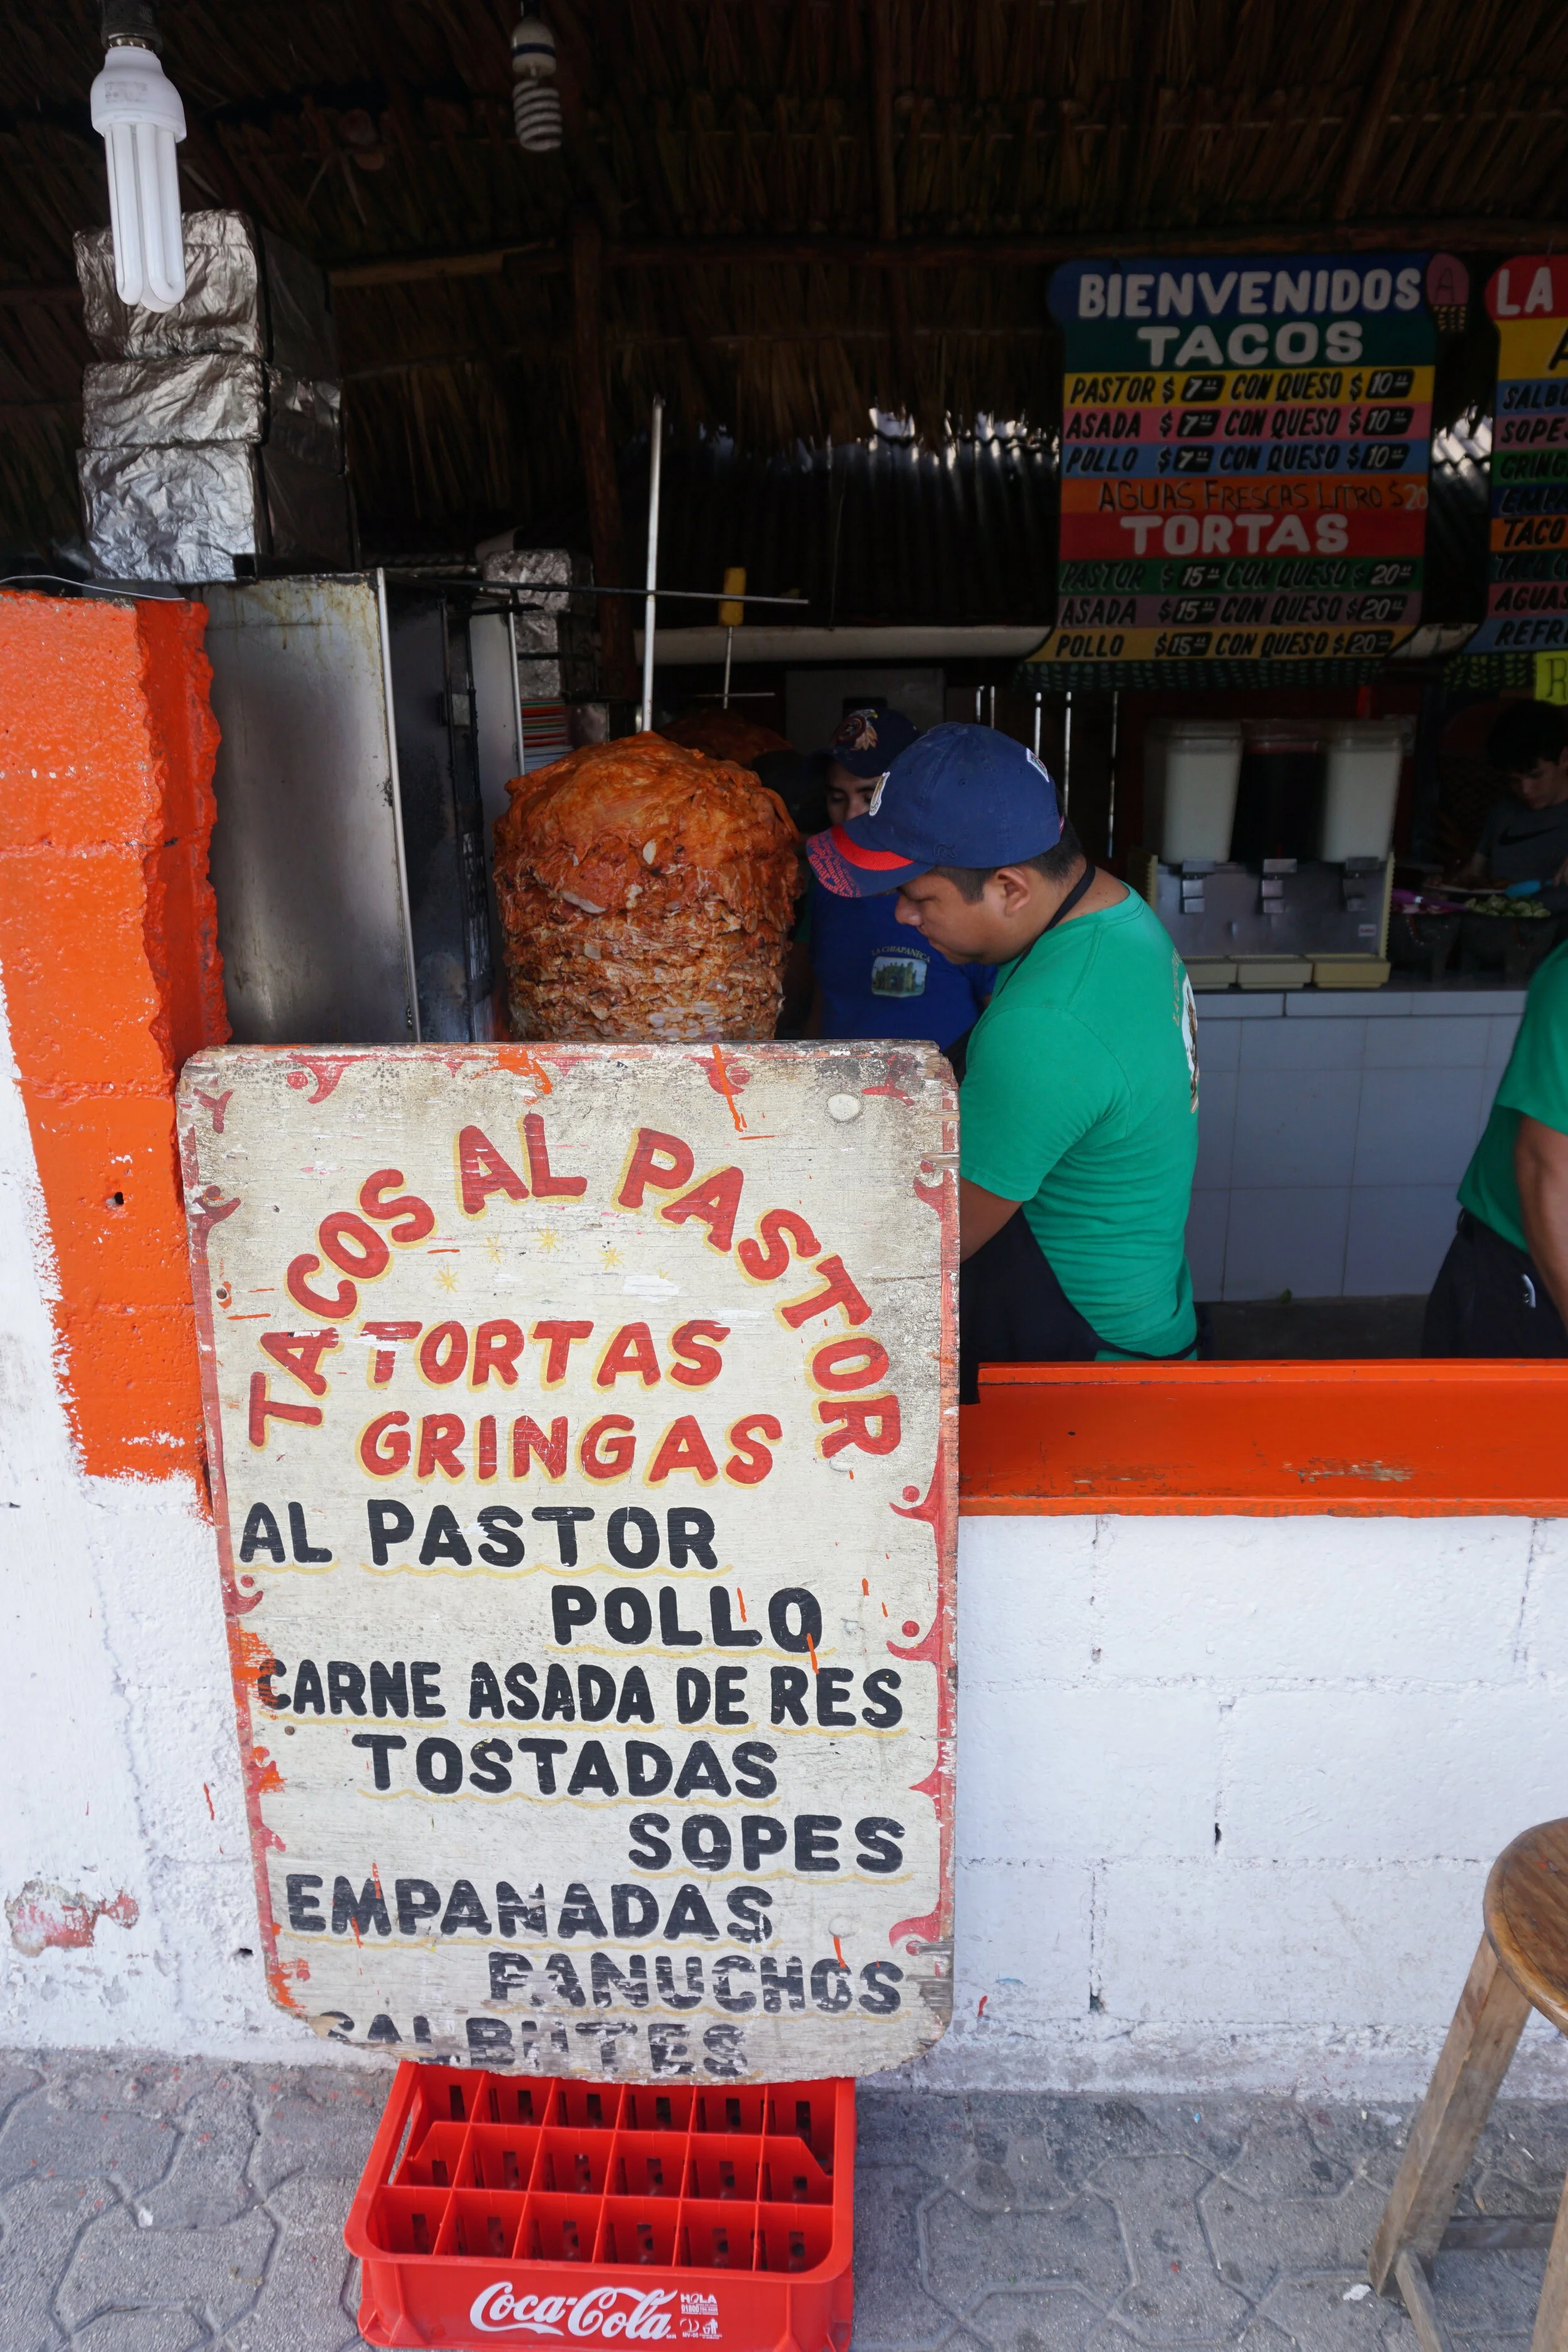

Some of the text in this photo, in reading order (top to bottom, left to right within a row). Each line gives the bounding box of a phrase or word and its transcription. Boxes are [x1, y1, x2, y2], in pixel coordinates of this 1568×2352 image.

[1078, 267, 1421, 318] BIENVENIDOS
[1496, 265, 1554, 315] LA
[1136, 320, 1364, 368] TACOS
[1070, 376, 1156, 404] PASTOR
[1231, 373, 1274, 401] CON
[1275, 372, 1344, 401] QUESO
[1066, 411, 1142, 438] ASADA
[1224, 410, 1268, 437] CON
[1270, 408, 1342, 440] QUESO
[1501, 416, 1568, 443] SOPE
[1066, 446, 1139, 473] POLLO
[1219, 445, 1262, 471] CON
[1266, 442, 1341, 472] QUESO
[1500, 451, 1568, 480] GRING
[1098, 480, 1196, 512] AGUAS
[1120, 512, 1350, 556] TORTAS
[1059, 561, 1147, 592] PASTOR
[1224, 560, 1273, 591] CON
[1274, 560, 1348, 591] QUESO
[1060, 597, 1136, 626] ASADA
[1221, 596, 1267, 625] CON
[1269, 596, 1343, 626] QUESO
[1494, 618, 1568, 647] REFR
[1056, 633, 1126, 658] POLLO
[1214, 632, 1259, 657] CON
[1259, 631, 1330, 659] QUESO
[249, 1113, 901, 1459] TACOS AL PASTOR
[360, 1318, 731, 1391] TORTAS
[358, 1410, 783, 1486] GRINGAS
[239, 1498, 719, 1569] AL PASTOR
[551, 1584, 823, 1653] POLLO
[258, 1659, 903, 1729] CARNE ASADA DE RES
[351, 1734, 778, 1799] TOSTADAS
[628, 1813, 906, 1874] SOPES
[285, 1873, 773, 1944] EMPANADAS
[488, 1951, 904, 2015] PANUCHOS
[470, 2280, 679, 2339] Coca-Cola
